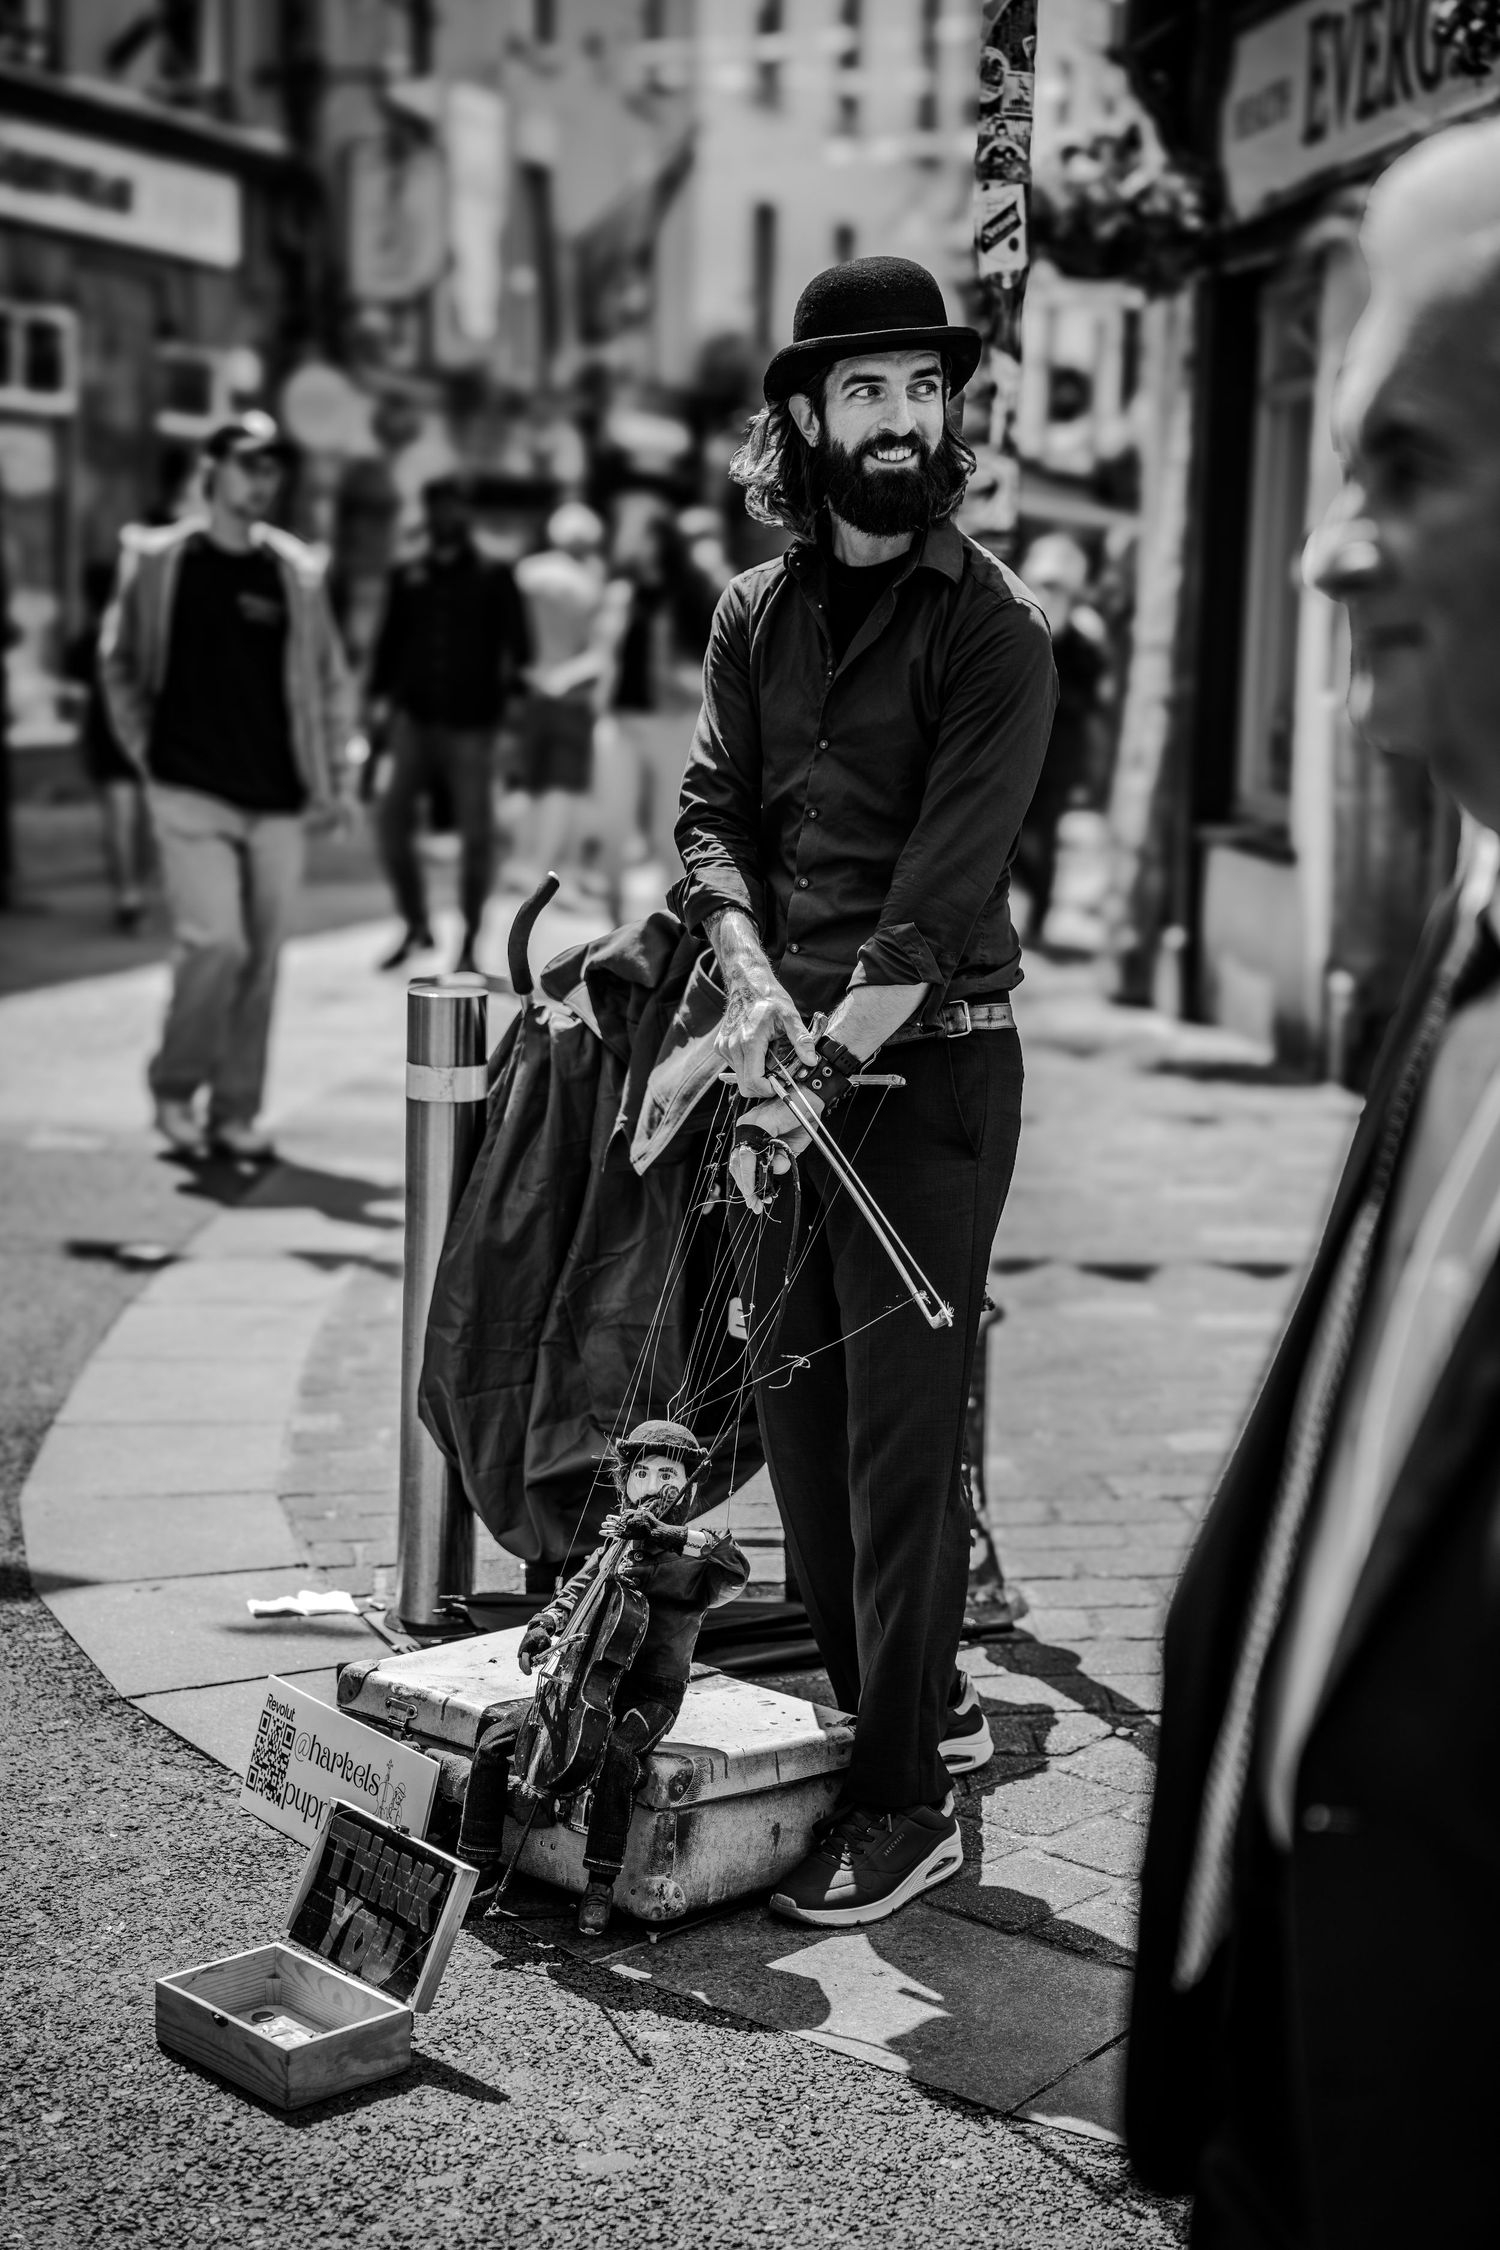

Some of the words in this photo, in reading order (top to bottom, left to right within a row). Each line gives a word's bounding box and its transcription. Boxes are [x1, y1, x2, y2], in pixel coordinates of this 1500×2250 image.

[1301, 0, 1446, 146] EVERG
[266, 1693, 296, 1722] Revolut
[294, 1732, 381, 1797] @harkels
[329, 1815, 444, 1934] THANK
[319, 1885, 407, 1985] YOU
